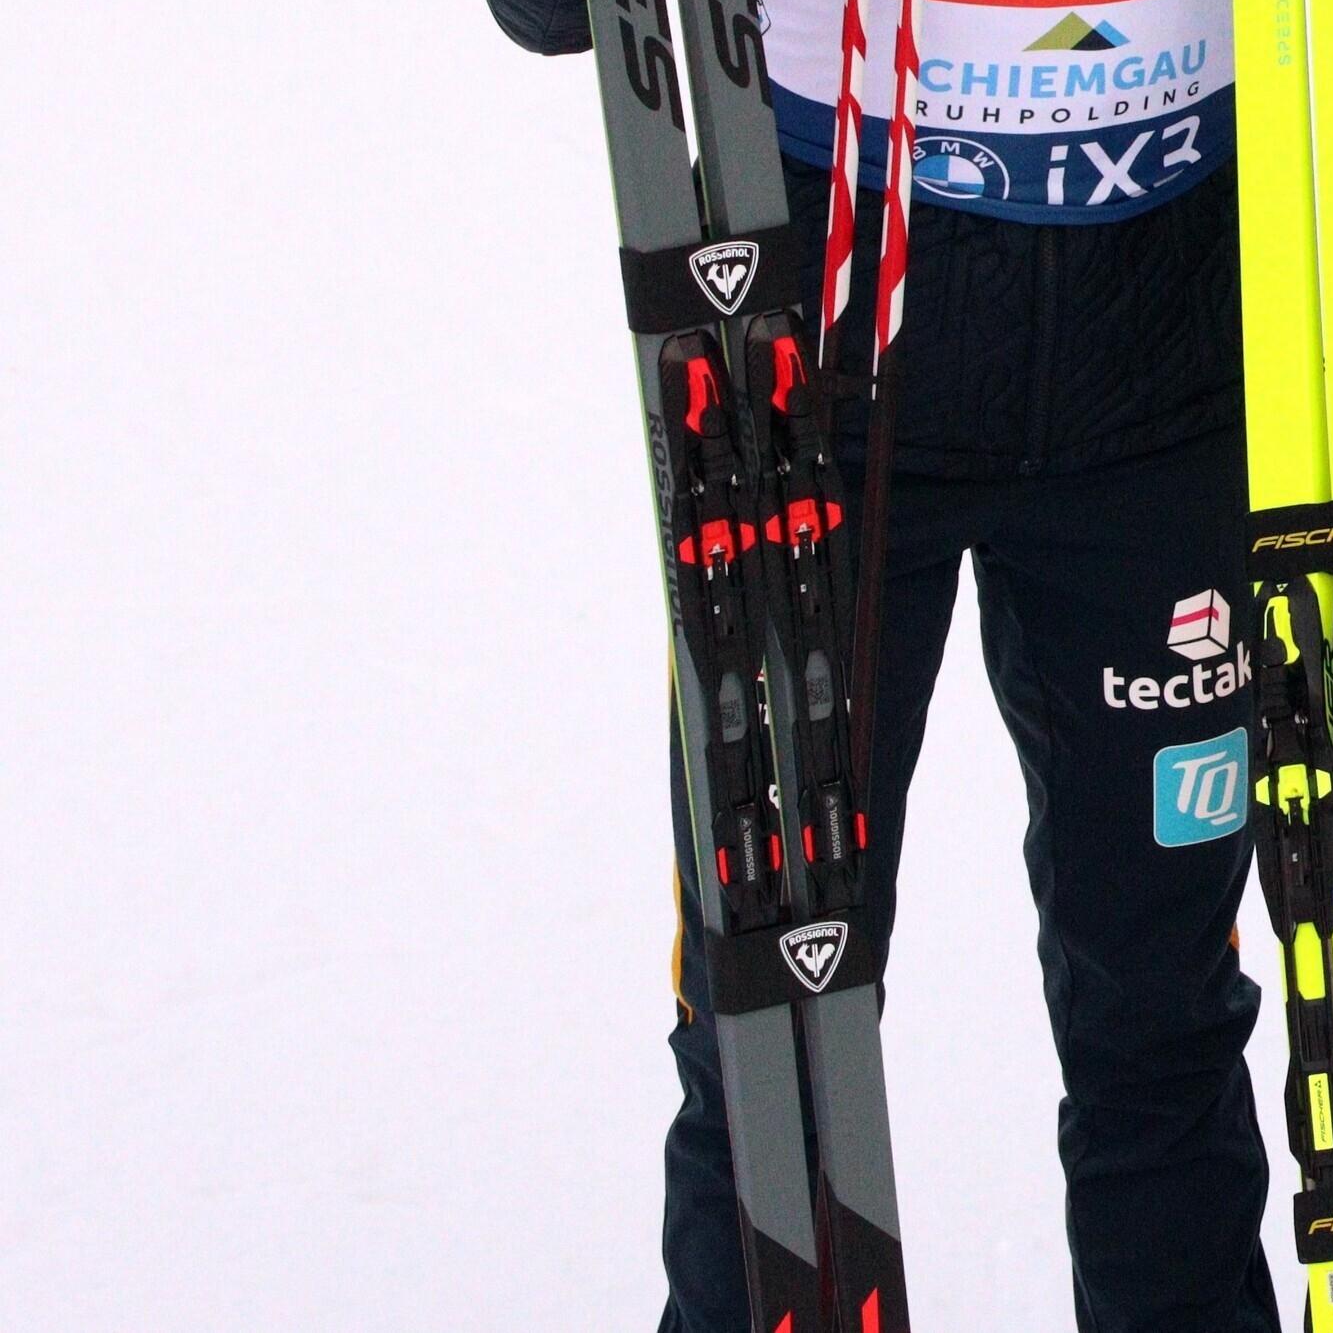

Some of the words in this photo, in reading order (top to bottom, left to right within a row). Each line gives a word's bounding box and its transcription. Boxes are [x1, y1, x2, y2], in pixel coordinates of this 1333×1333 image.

[919, 39, 1207, 99] CHIEMGAU
[916, 80, 1200, 124] RUHPOLDING
[1047, 114, 1202, 206] iX3
[699, 248, 750, 267] ROSSIGNOL
[1102, 641, 1252, 711] tectak
[787, 928, 839, 947] ROSSIGNOL
[1318, 1088, 1329, 1144] FISCHER
